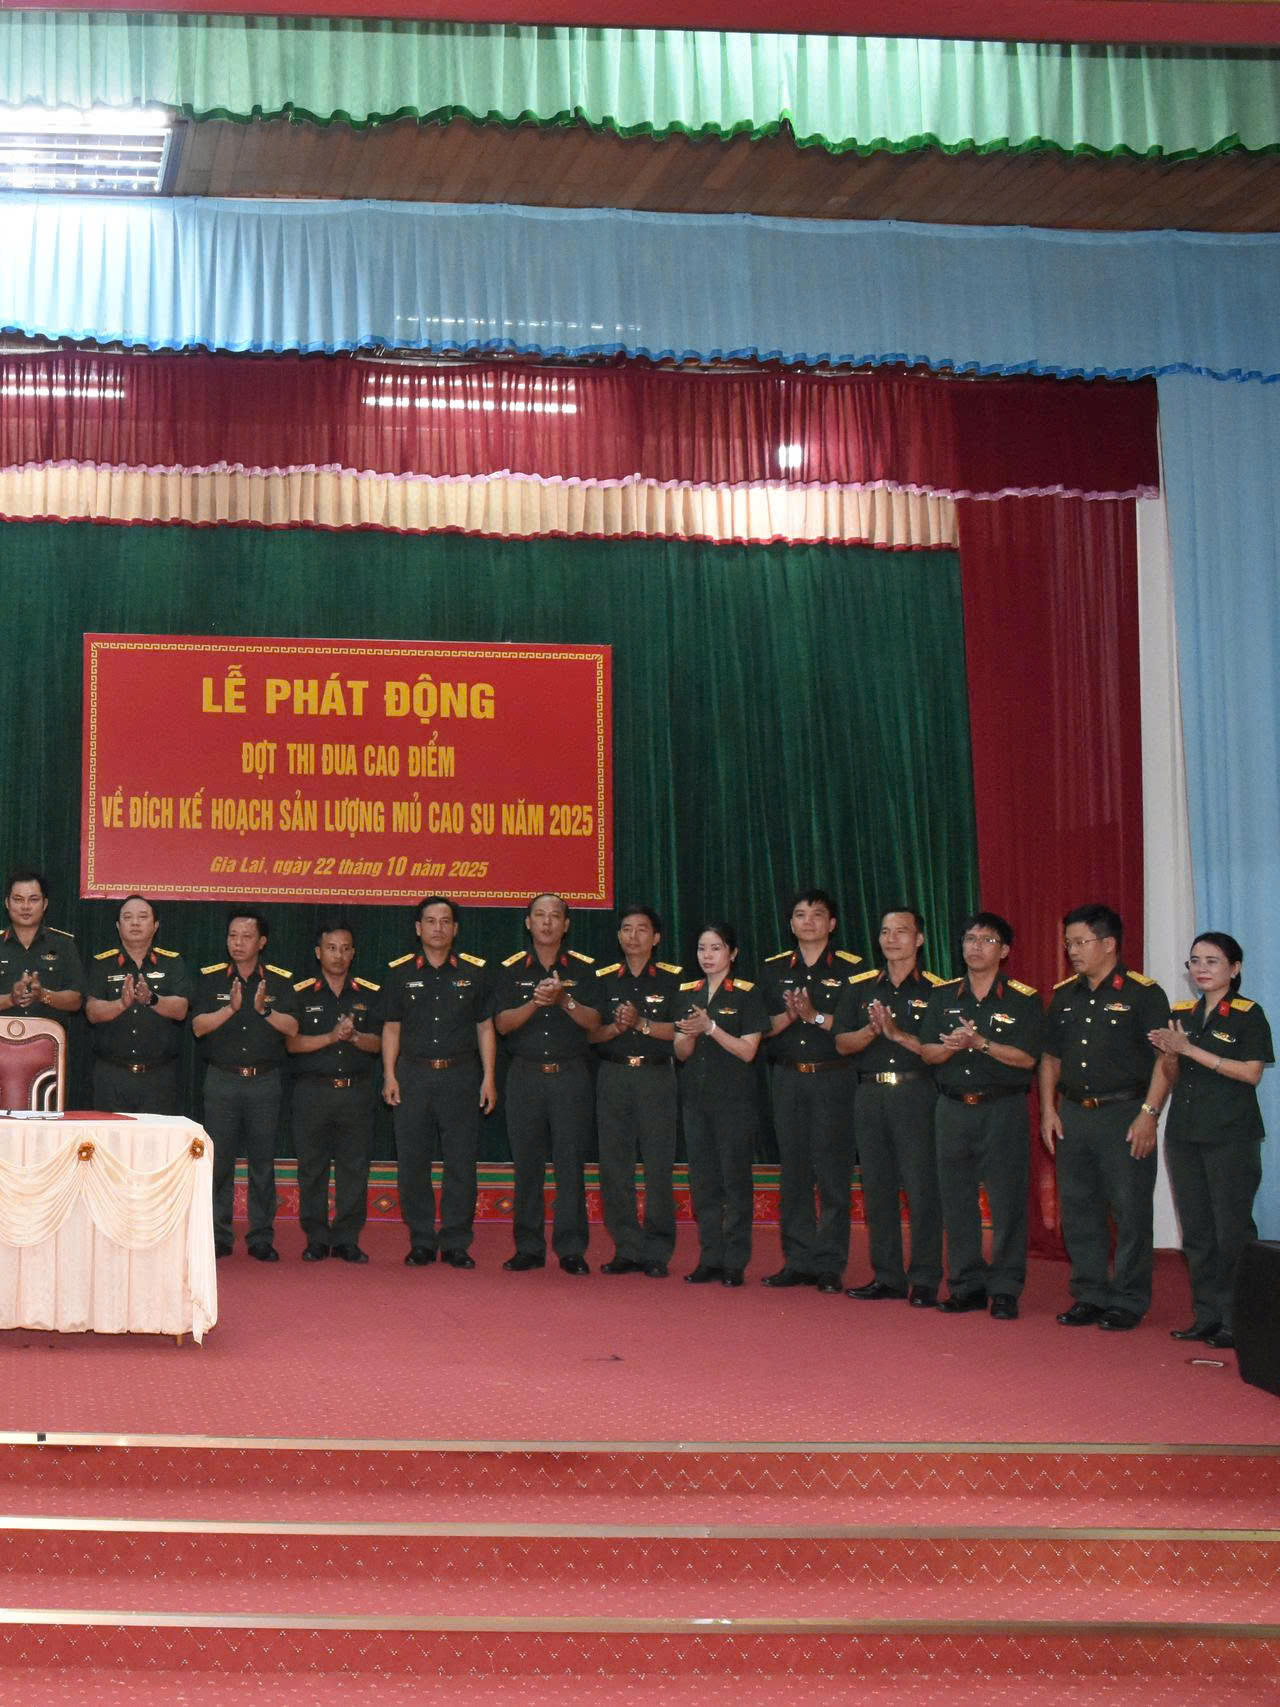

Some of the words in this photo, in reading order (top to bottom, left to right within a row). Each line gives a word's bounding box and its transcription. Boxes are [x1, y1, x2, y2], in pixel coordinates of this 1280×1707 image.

[202, 664, 247, 713] LỄ
[265, 672, 369, 716] PHÁT
[384, 673, 495, 724] ĐỘNG
[241, 739, 277, 780] ĐỢT
[287, 743, 315, 775] THI
[321, 743, 358, 776] ĐUA
[364, 744, 400, 777] CAO
[408, 730, 455, 777] ĐIỂM
[101, 785, 124, 828] VỀ
[129, 791, 173, 829] ĐÍCH
[179, 787, 205, 829] KẾ
[211, 798, 273, 836] HOẠCH
[279, 789, 318, 832] SẢN
[324, 797, 385, 838] LƯỢNG
[392, 792, 422, 833] MỦ
[428, 801, 465, 834] CAO
[470, 803, 495, 835] SU
[501, 798, 544, 836] NĂM
[549, 804, 593, 837] 2025
[210, 856, 237, 873] Gia
[272, 856, 312, 876] ngày
[313, 857, 336, 875] 22
[338, 857, 384, 877] tháng
[386, 856, 408, 877] 10
[410, 859, 446, 877] năm
[447, 861, 489, 877] 2025
